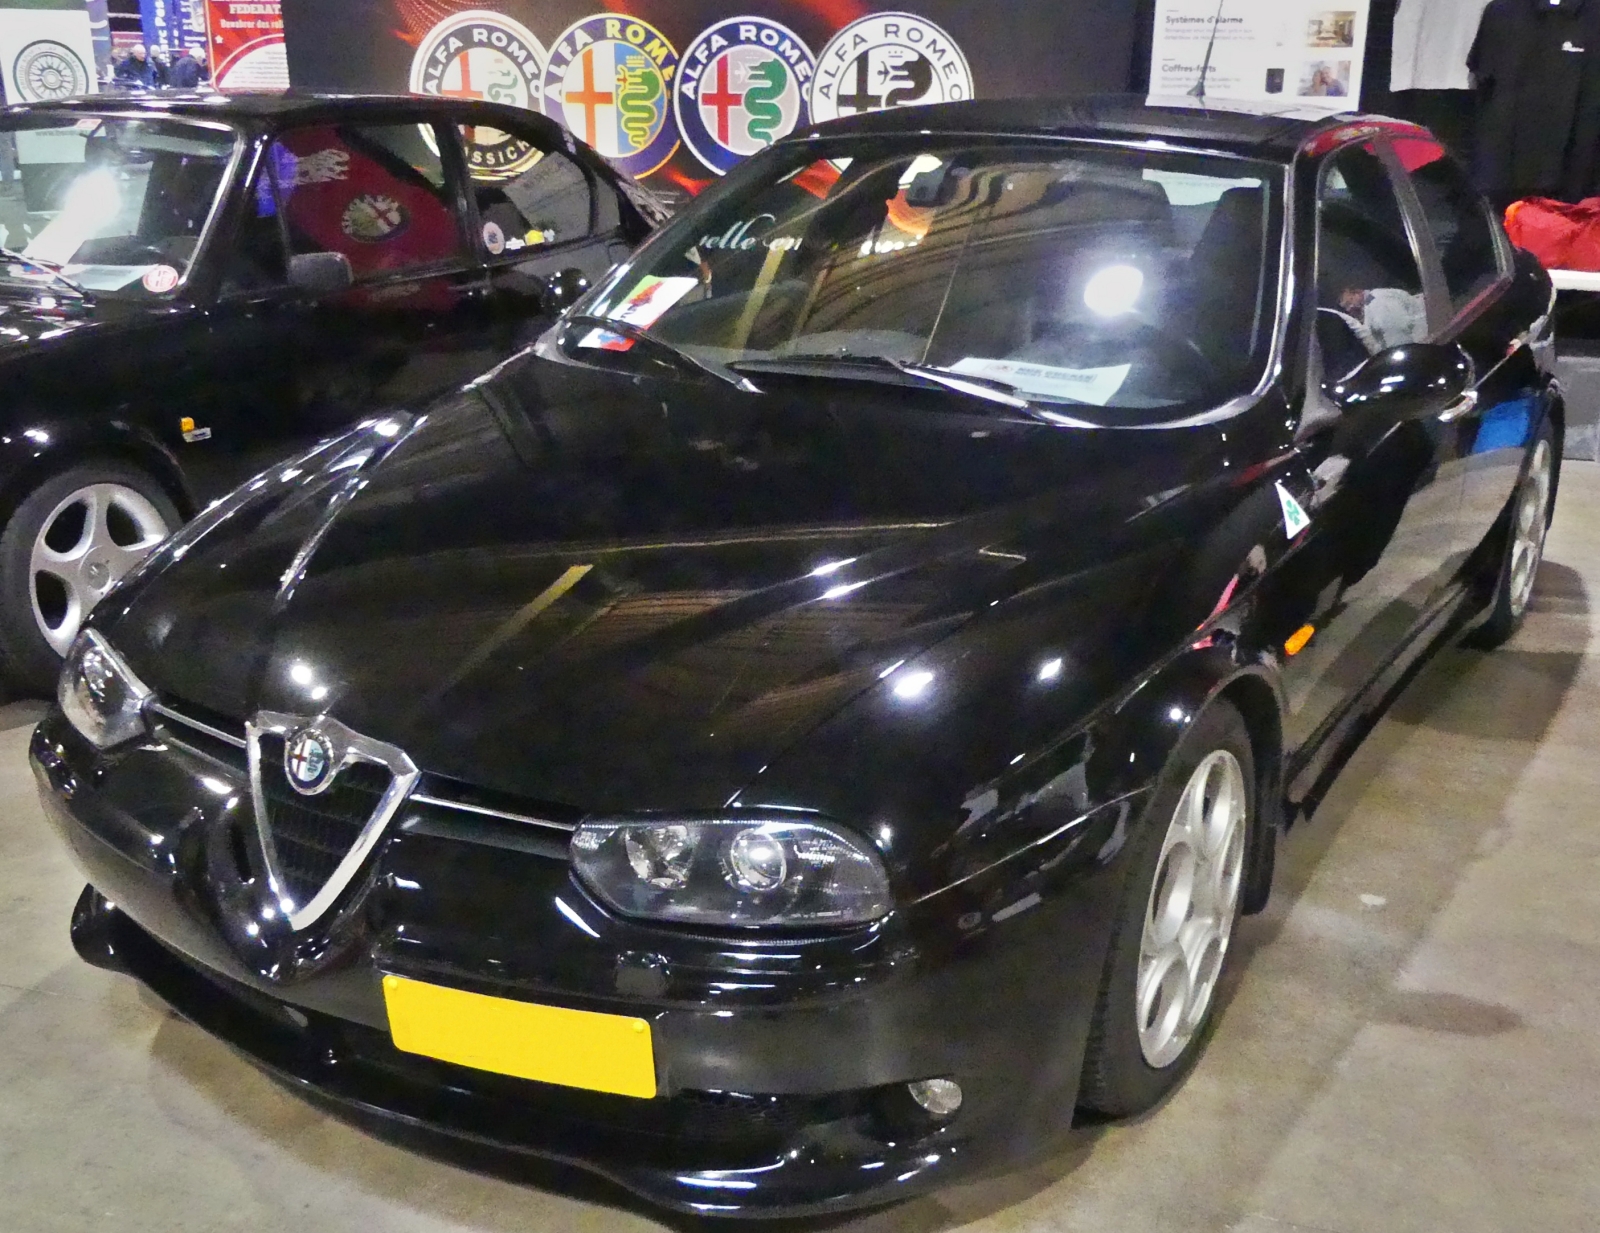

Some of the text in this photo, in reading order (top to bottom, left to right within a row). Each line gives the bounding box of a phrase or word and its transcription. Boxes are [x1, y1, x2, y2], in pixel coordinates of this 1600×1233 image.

[1165, 15, 1205, 25] Systèmes
[424, 28, 541, 99] ALFA ROMEO
[545, 28, 594, 104] ALFA
[681, 34, 729, 100] ALFA
[817, 23, 963, 101] ALFA ROMEO
